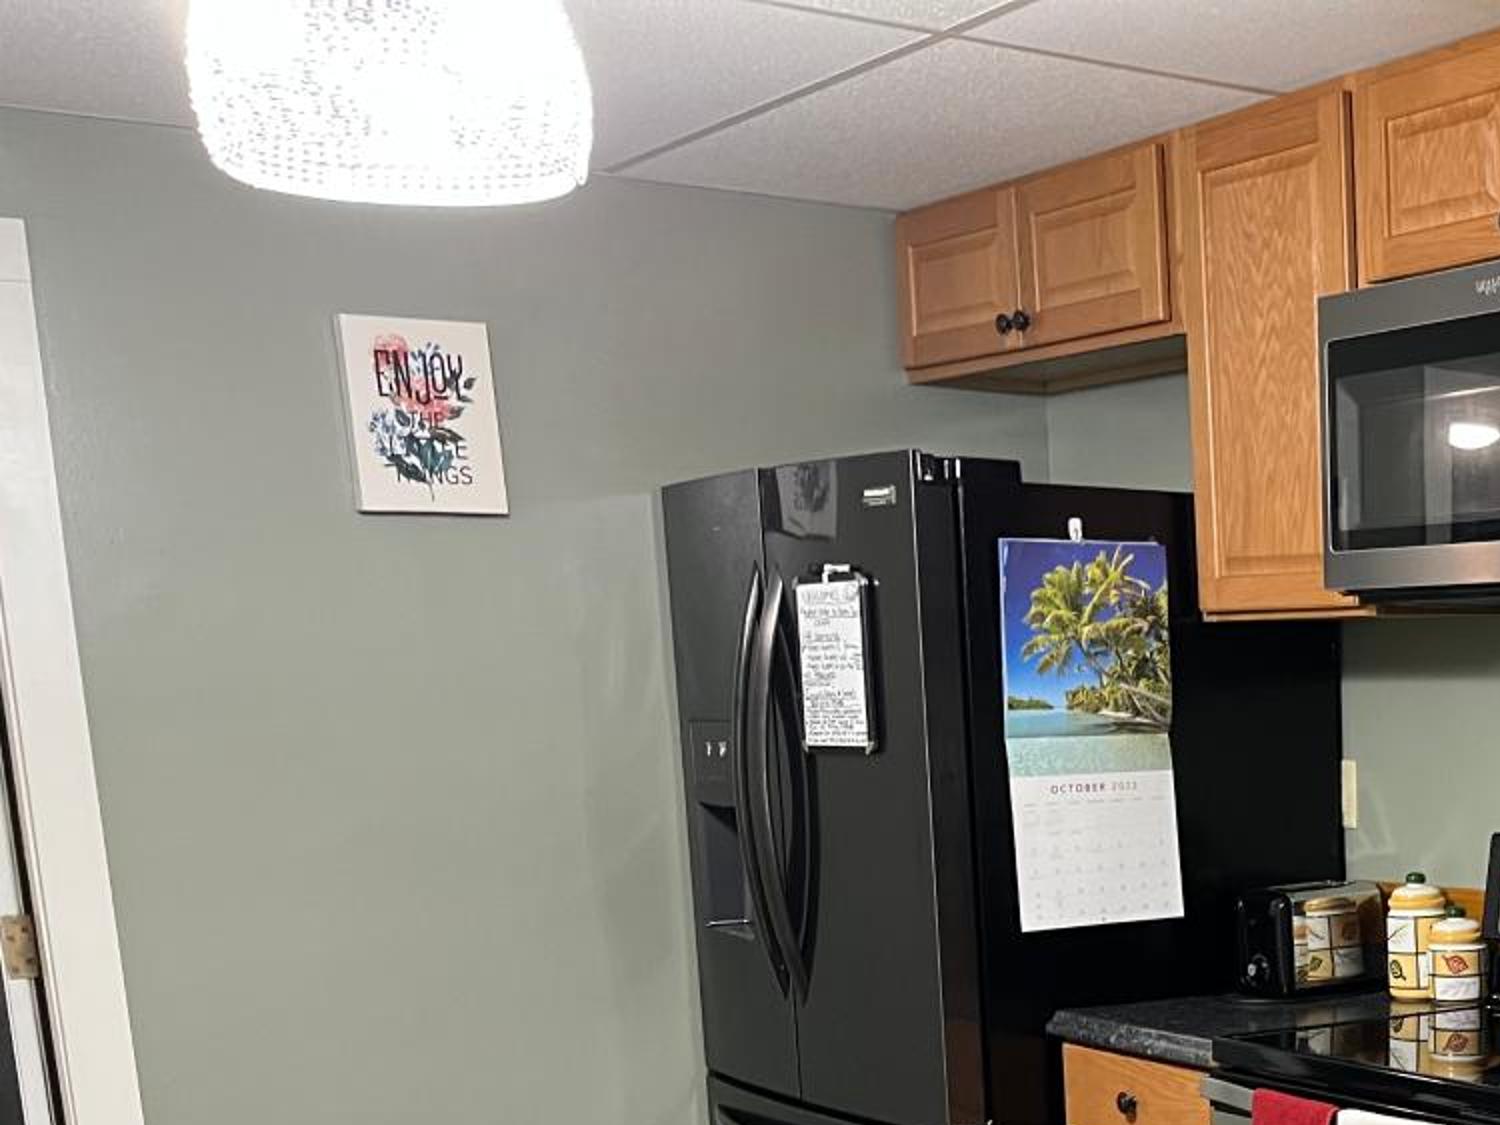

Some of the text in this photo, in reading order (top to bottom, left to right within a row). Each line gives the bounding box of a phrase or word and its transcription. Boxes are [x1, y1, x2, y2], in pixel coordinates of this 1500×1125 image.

[374, 347, 463, 405] ENJOY
[384, 463, 473, 485] TNGS
[1050, 783, 1105, 795] OCTOBER
